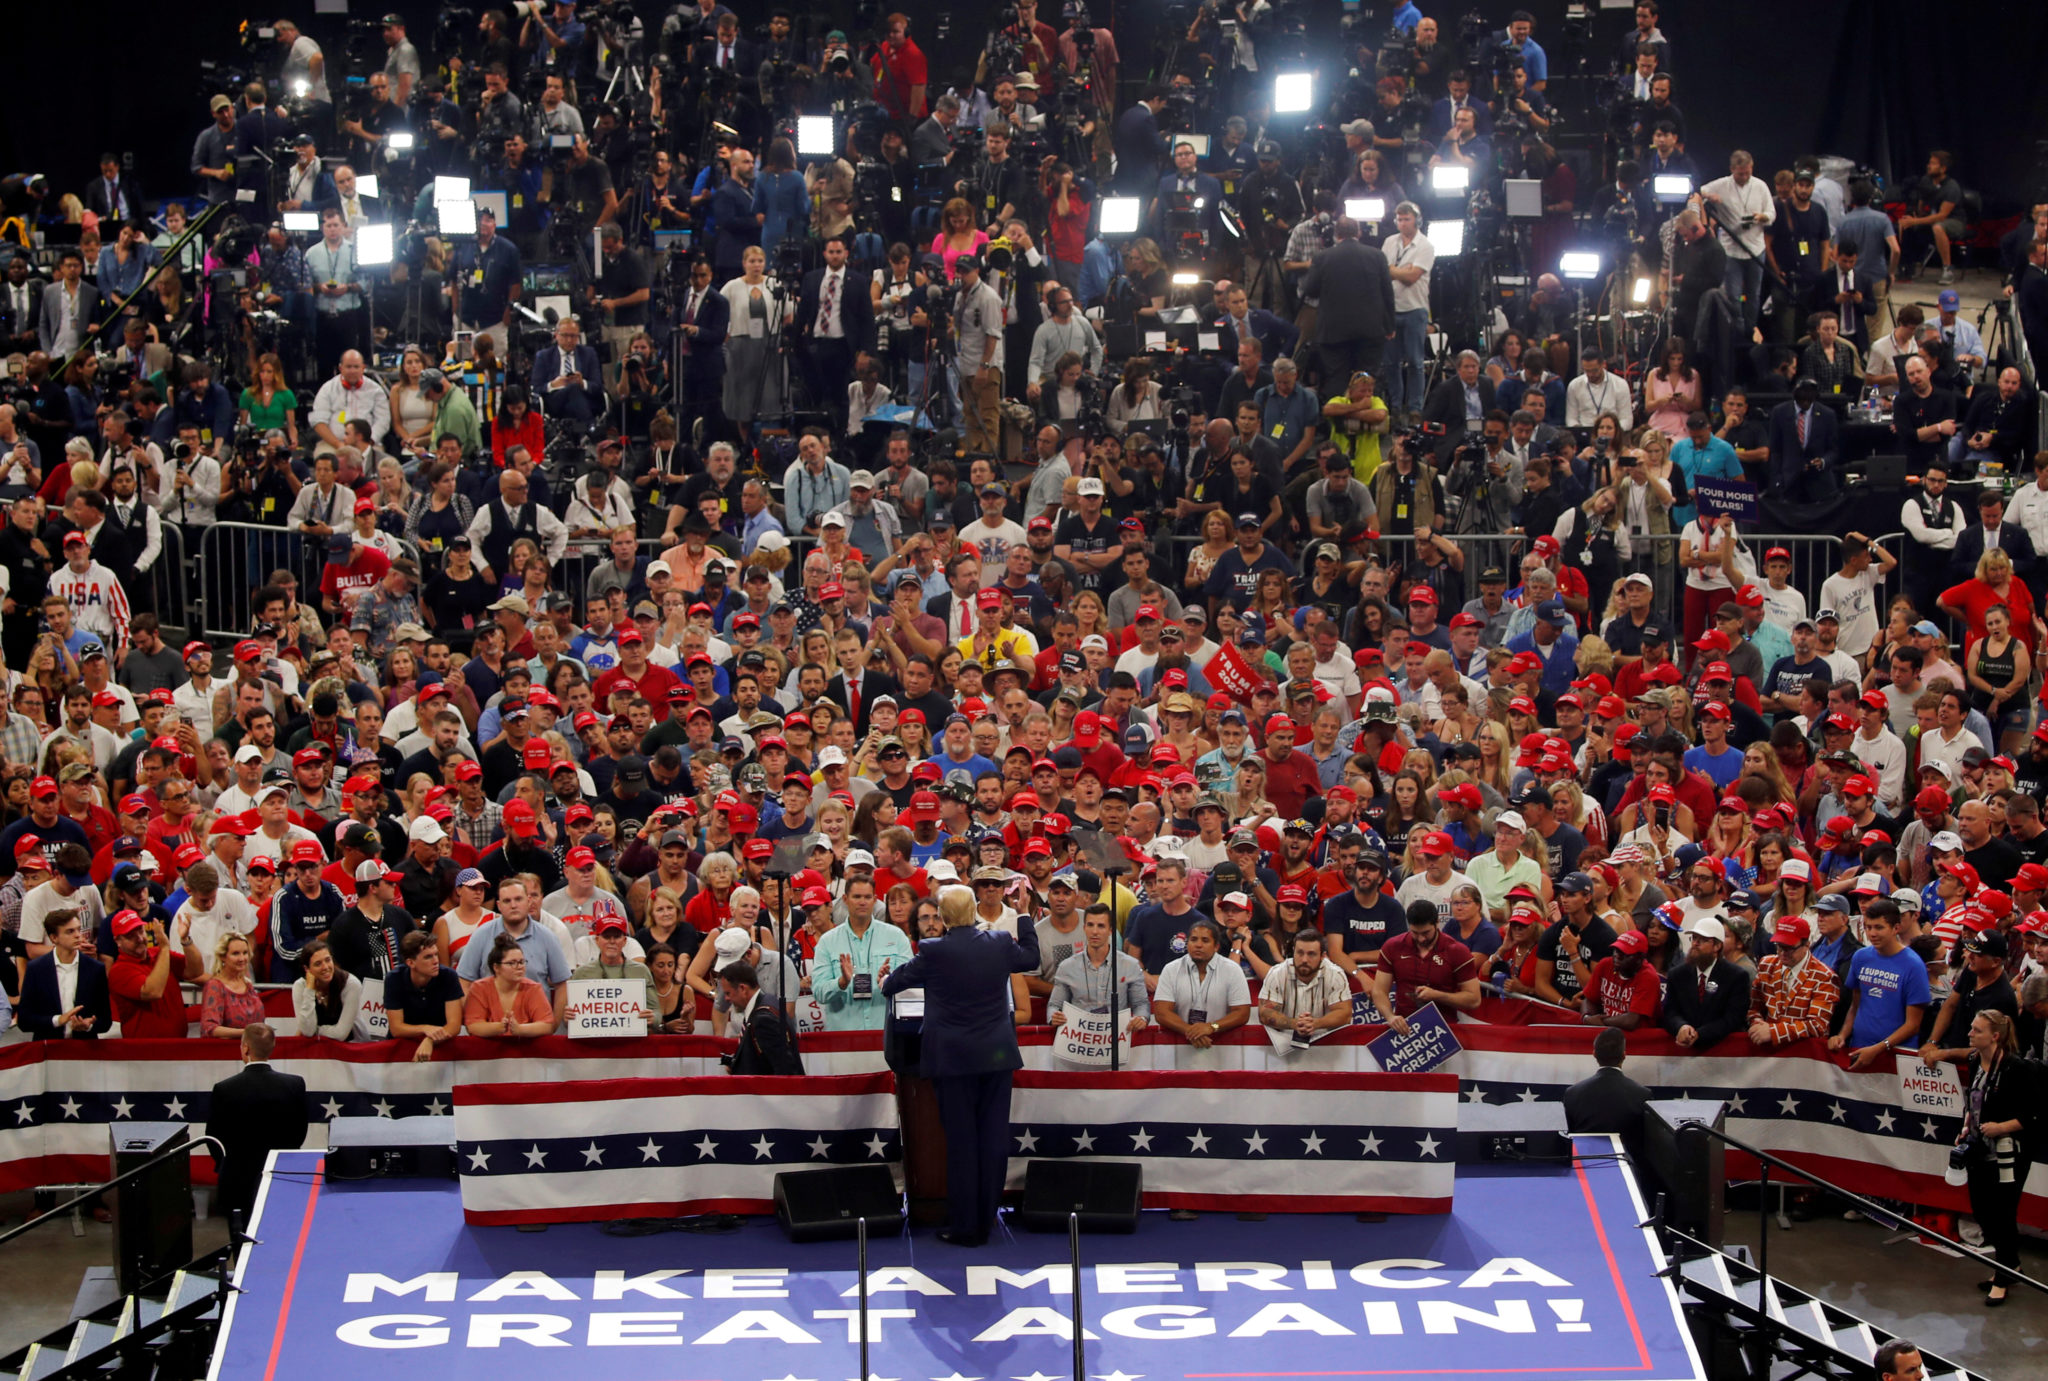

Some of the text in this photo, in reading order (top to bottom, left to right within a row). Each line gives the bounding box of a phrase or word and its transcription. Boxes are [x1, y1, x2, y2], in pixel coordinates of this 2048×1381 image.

[1698, 487, 1755, 502] FOUR MORE
[1709, 499, 1744, 512] YEARS!
[336, 573, 374, 588] BUILT
[60, 582, 102, 606] USA
[1218, 651, 1256, 693] TRUM
[1217, 670, 1243, 696] 2020
[1865, 968, 1900, 982] SUPPORT
[1873, 977, 1899, 989] SPEECH
[587, 988, 623, 999] KEEP
[572, 1001, 641, 1015] AMERICA
[581, 1017, 631, 1028] GREAT!
[1078, 1018, 1112, 1032] KEEP
[1061, 1026, 1127, 1045] AMERICA
[1390, 1022, 1421, 1048] KEEP
[1385, 1025, 1447, 1071] AMERICA
[1401, 1042, 1446, 1073] GREAT!
[1915, 1066, 1943, 1078] KEEP
[1903, 1077, 1959, 1096] AMERICA
[1912, 1094, 1953, 1108] GREAT!
[343, 1257, 1575, 1303] MAKE AMERICA
[335, 1298, 1592, 1349] GREAT AGAIN!
